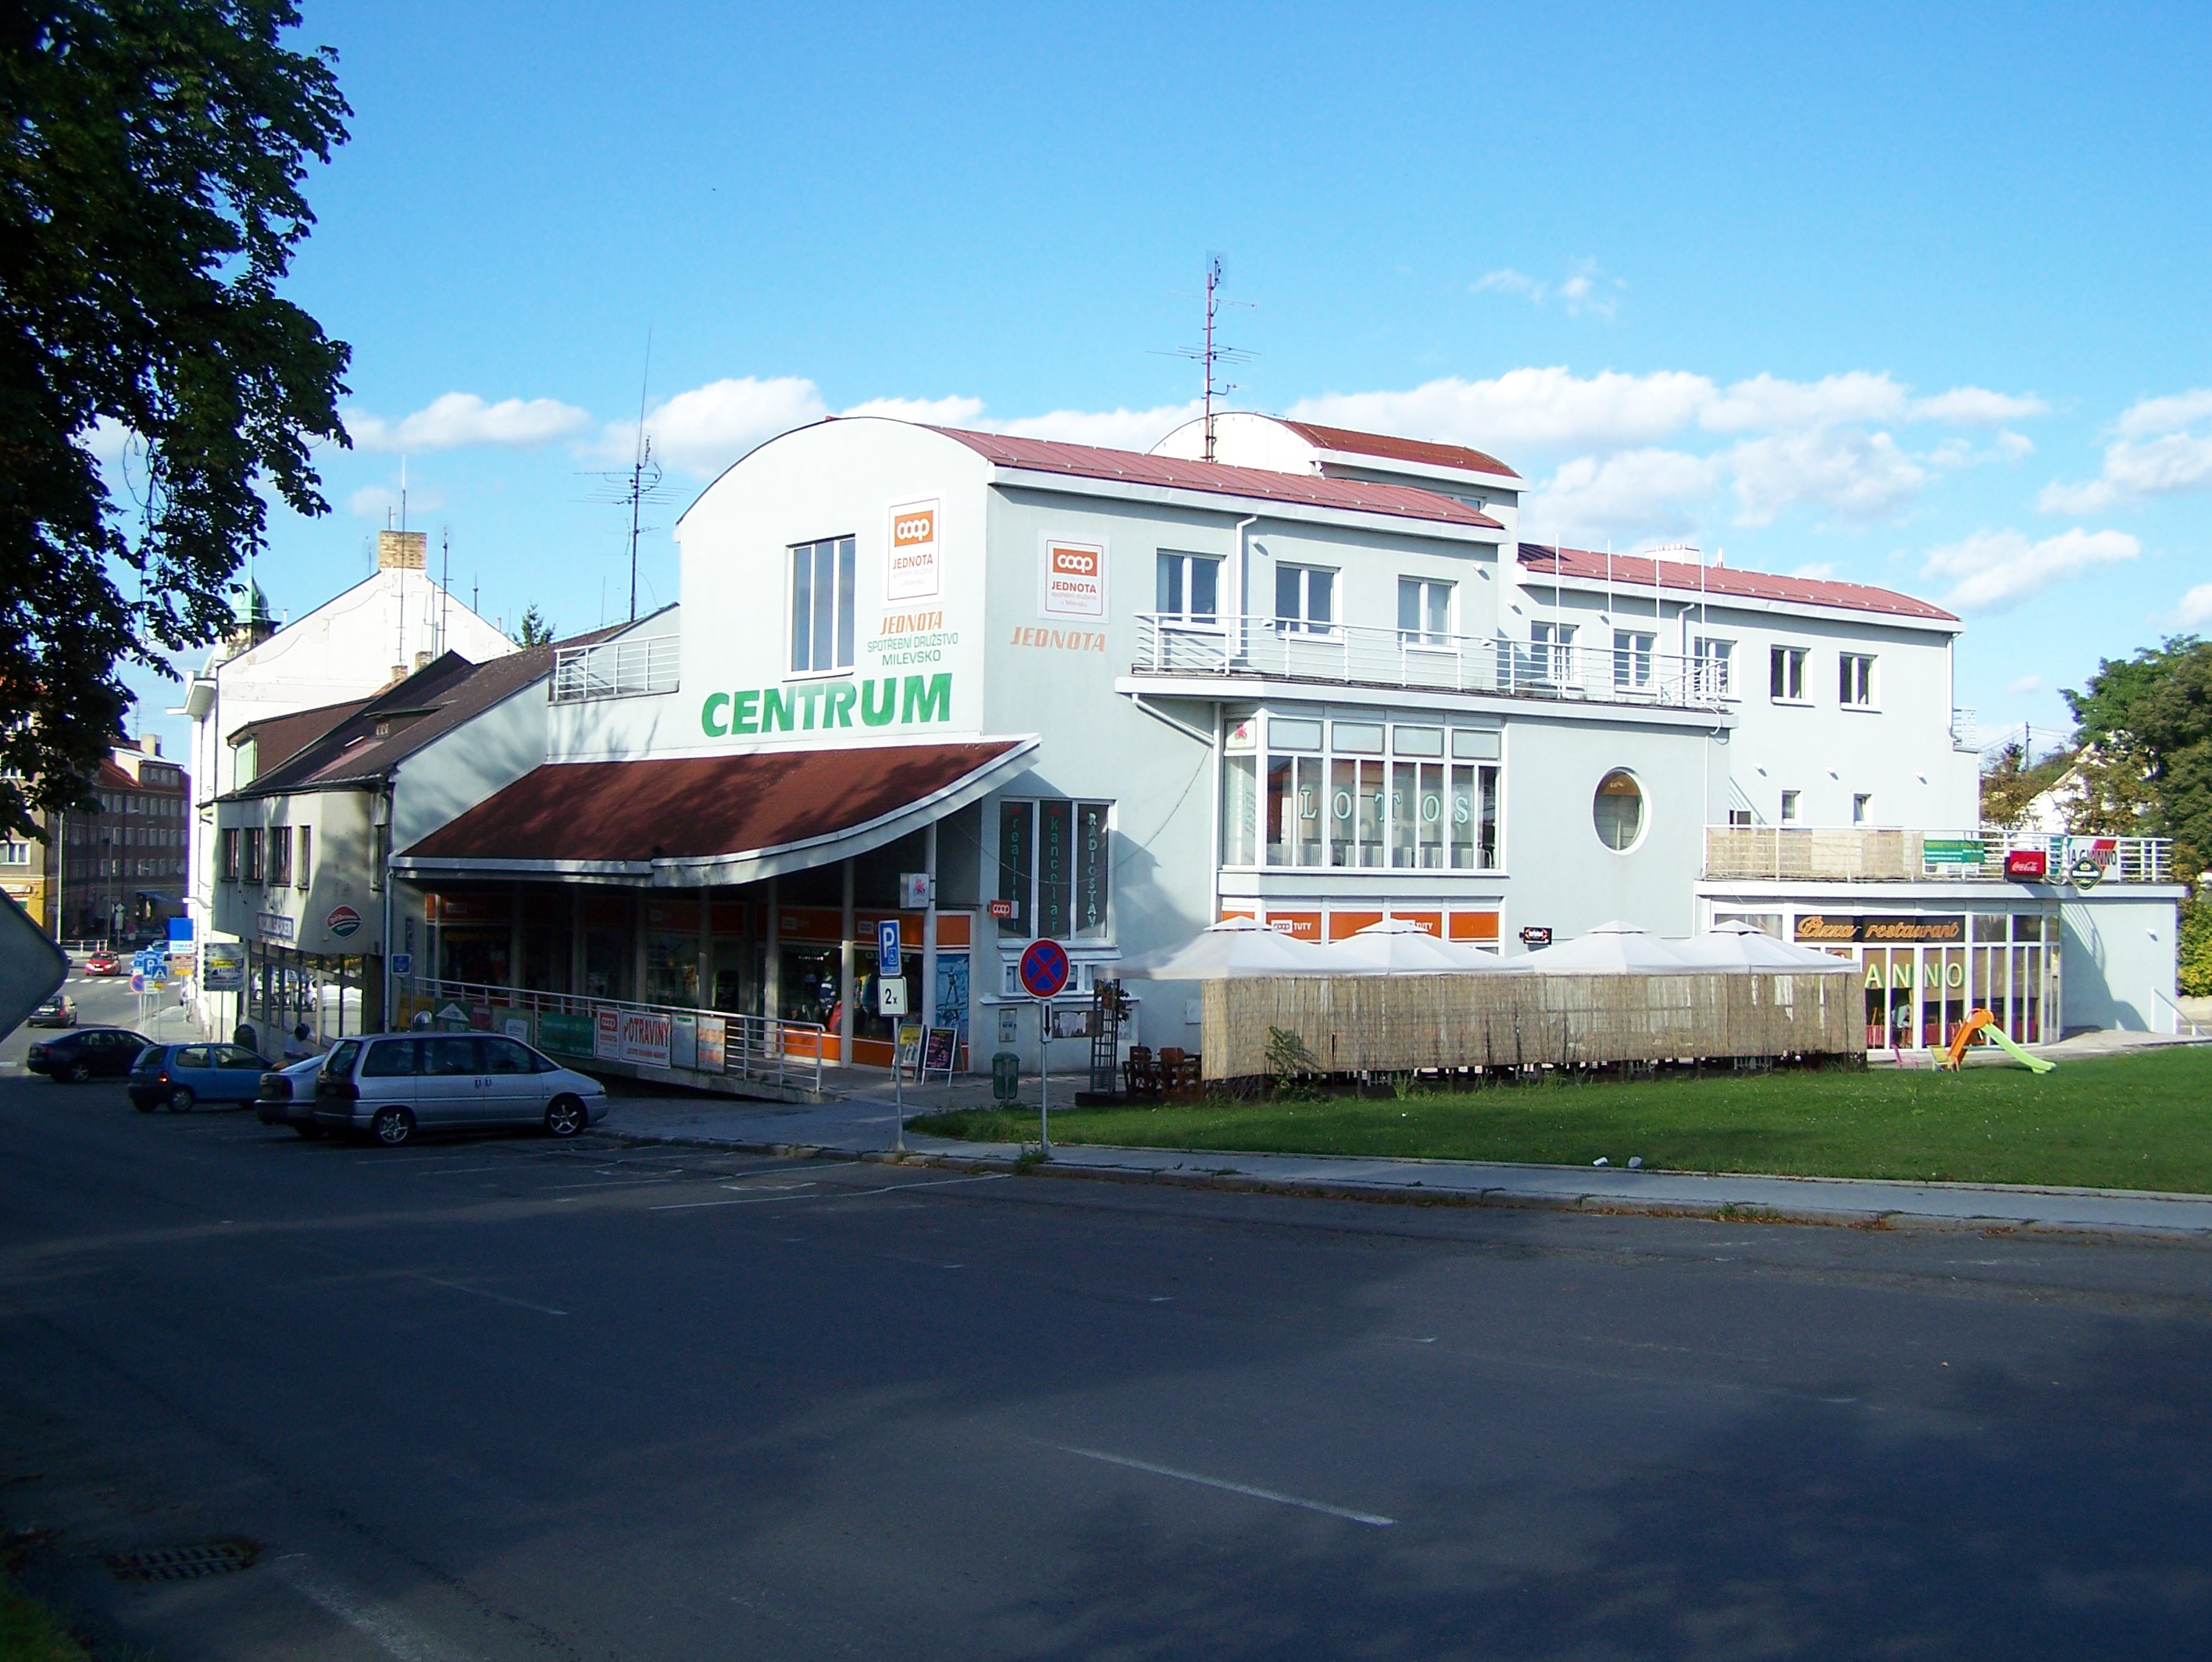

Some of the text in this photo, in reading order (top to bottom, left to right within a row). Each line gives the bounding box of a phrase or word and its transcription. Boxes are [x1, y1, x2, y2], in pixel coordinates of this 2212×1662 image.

[897, 518, 930, 541] coop
[893, 554, 933, 569] JEDNOTA
[1057, 554, 1094, 573] coop
[1051, 581, 1097, 594] JEDNOTA
[879, 611, 943, 635] JEDNOTA
[867, 632, 958, 653] SPOTŘEBNÍ DRUŽSTVO
[1010, 626, 1106, 651] JEDNOTA
[882, 649, 941, 666] MILEVSKO
[701, 672, 953, 737] CENTRUM
[1300, 789, 1469, 824] LOTOS
[993, 904, 1010, 916] coop
[1293, 922, 1312, 930] TUTY
[1794, 916, 1960, 938] Pizza restaurant
[883, 927, 895, 958] P
[625, 1017, 671, 1048] POTRAVINY
